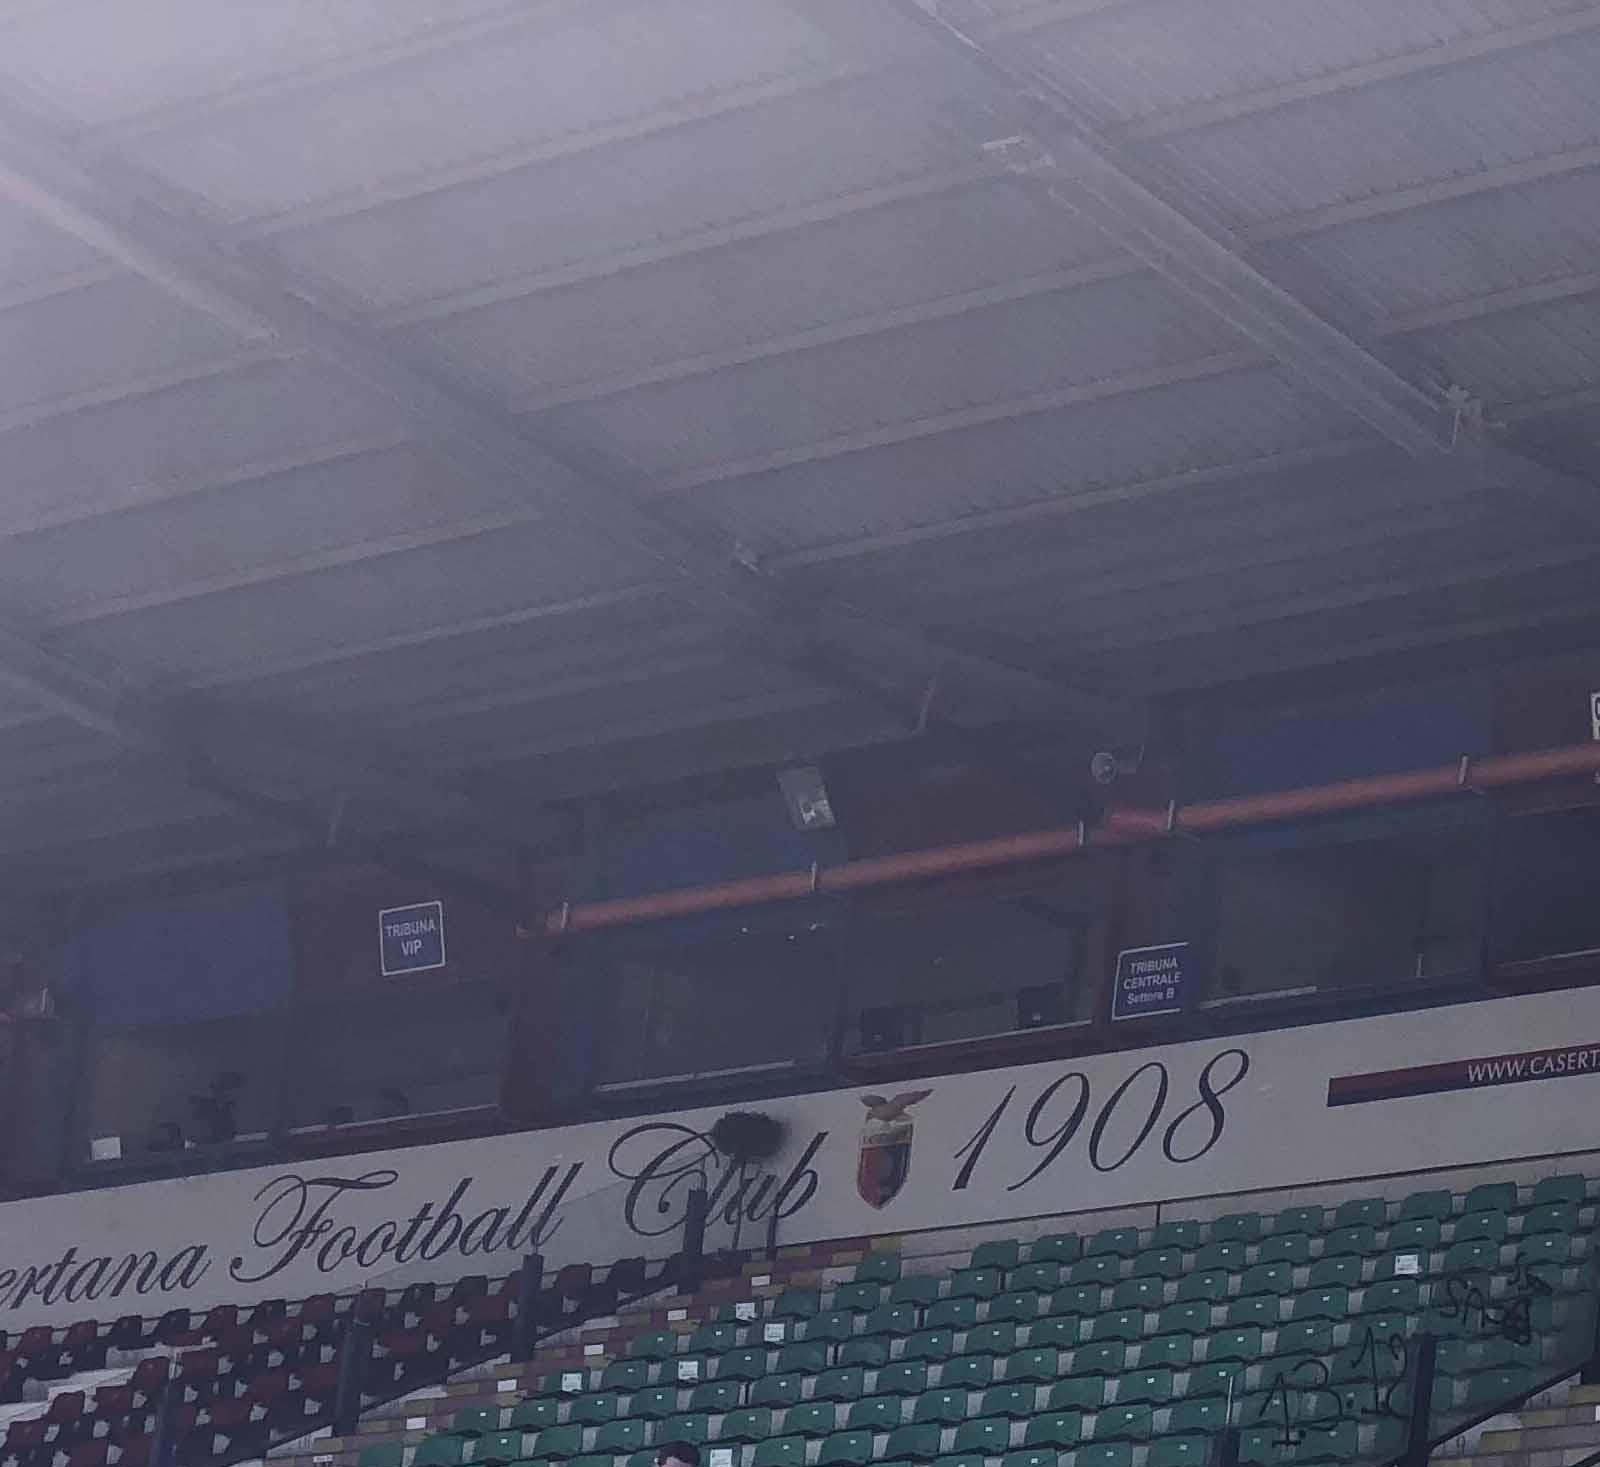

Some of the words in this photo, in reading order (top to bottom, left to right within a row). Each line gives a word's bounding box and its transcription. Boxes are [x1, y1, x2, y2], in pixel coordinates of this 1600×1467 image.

[385, 918, 436, 937] TRIBUNA
[401, 939, 422, 956] VIP
[1130, 957, 1178, 974] TRIBUNA
[1123, 971, 1182, 989] CENTRALE
[230, 1170, 583, 1279] Football
[953, 1049, 1249, 1191] 1908
